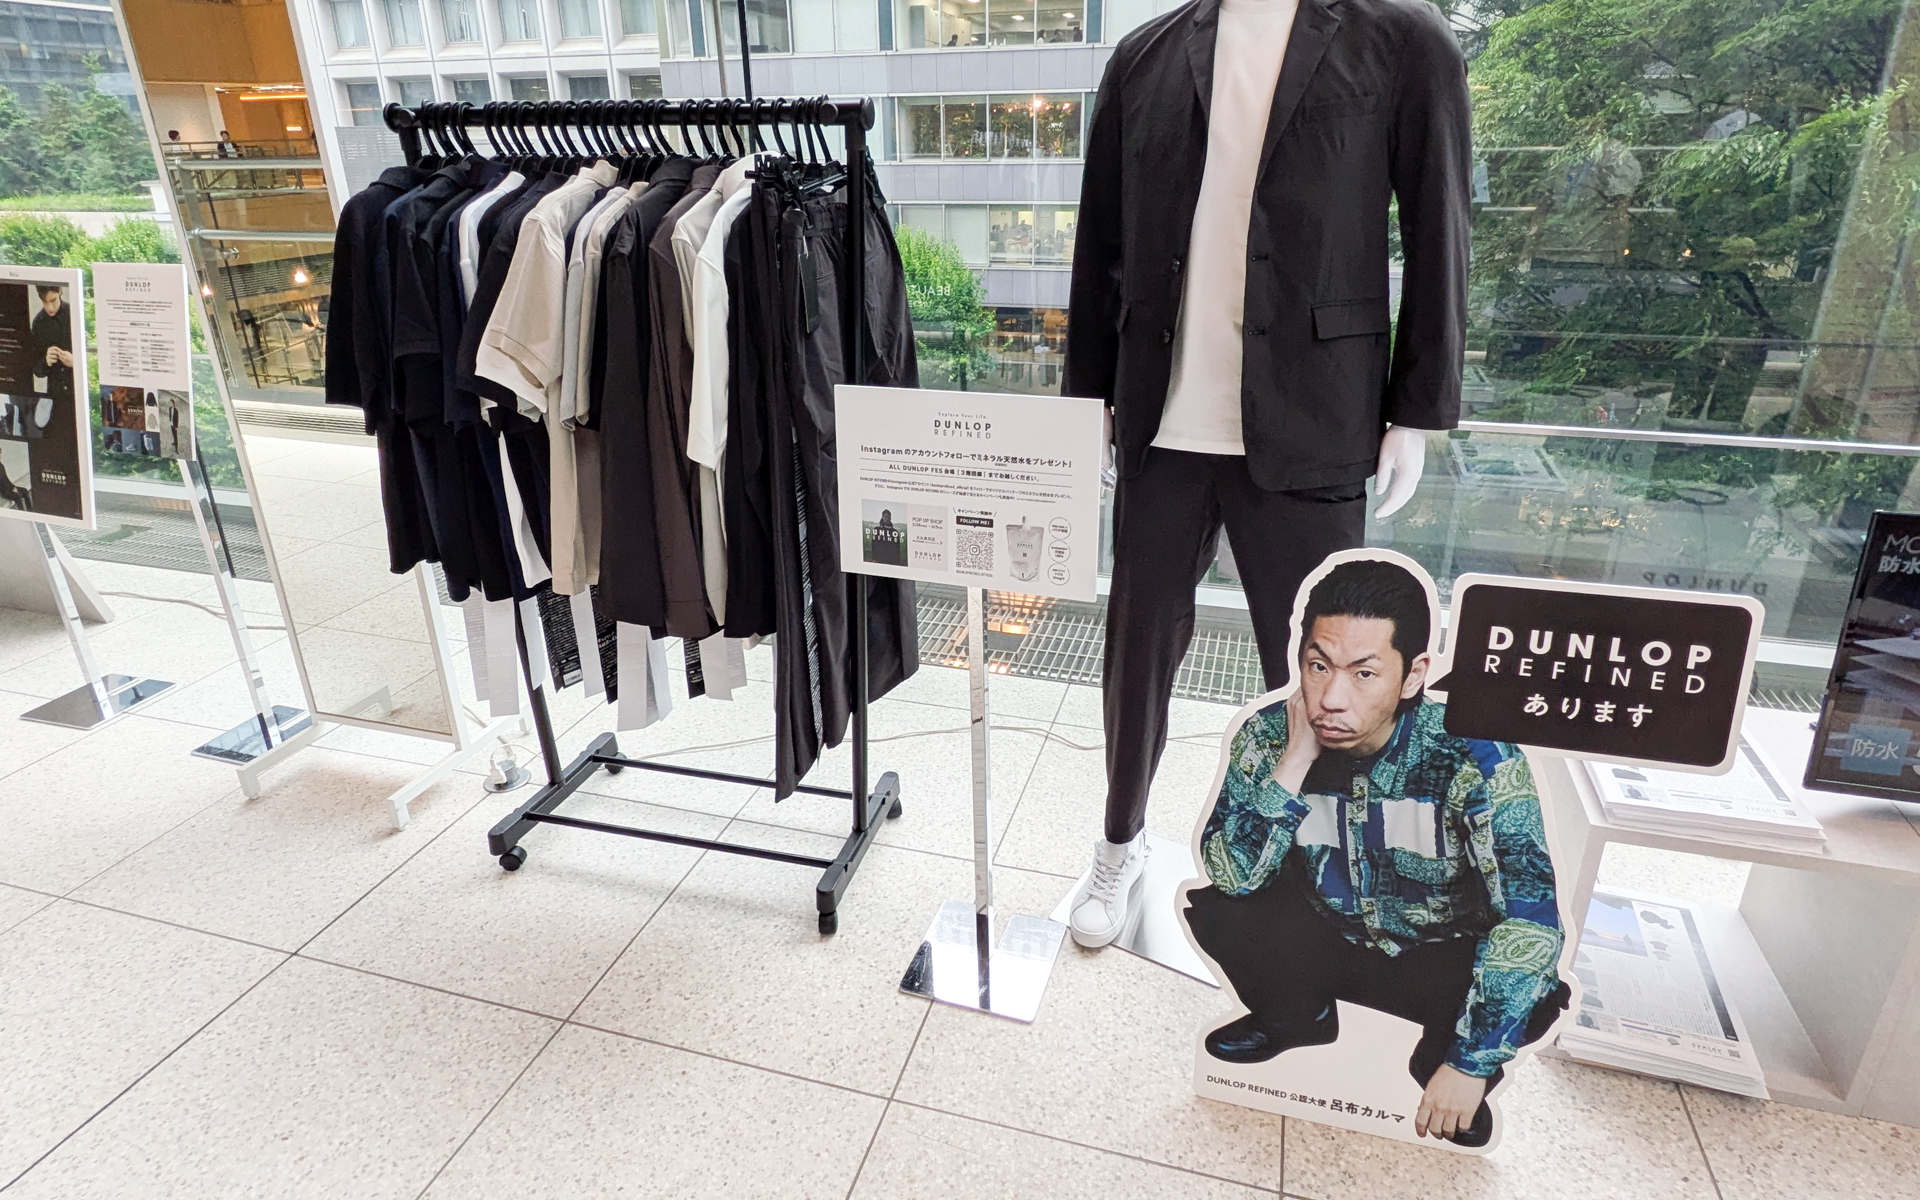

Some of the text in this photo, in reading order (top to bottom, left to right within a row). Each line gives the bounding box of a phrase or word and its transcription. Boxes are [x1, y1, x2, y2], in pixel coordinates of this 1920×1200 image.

[934, 419, 991, 432] DUNLOP
[933, 428, 991, 439] REFINED
[860, 444, 903, 455] Instagram
[902, 465, 929, 473] DUNLOP
[959, 517, 979, 525] FOLLOW
[865, 528, 905, 538] DUNLOP
[914, 550, 942, 558] DUNLOP
[1488, 626, 1712, 670] DUNLOP
[1484, 655, 1706, 695] REFINED
[1523, 693, 1653, 728] あります
[1851, 738, 1899, 760] 防水
[1206, 1074, 1406, 1124] DUNLOP REFINED 公認大使 呂布カルマ
